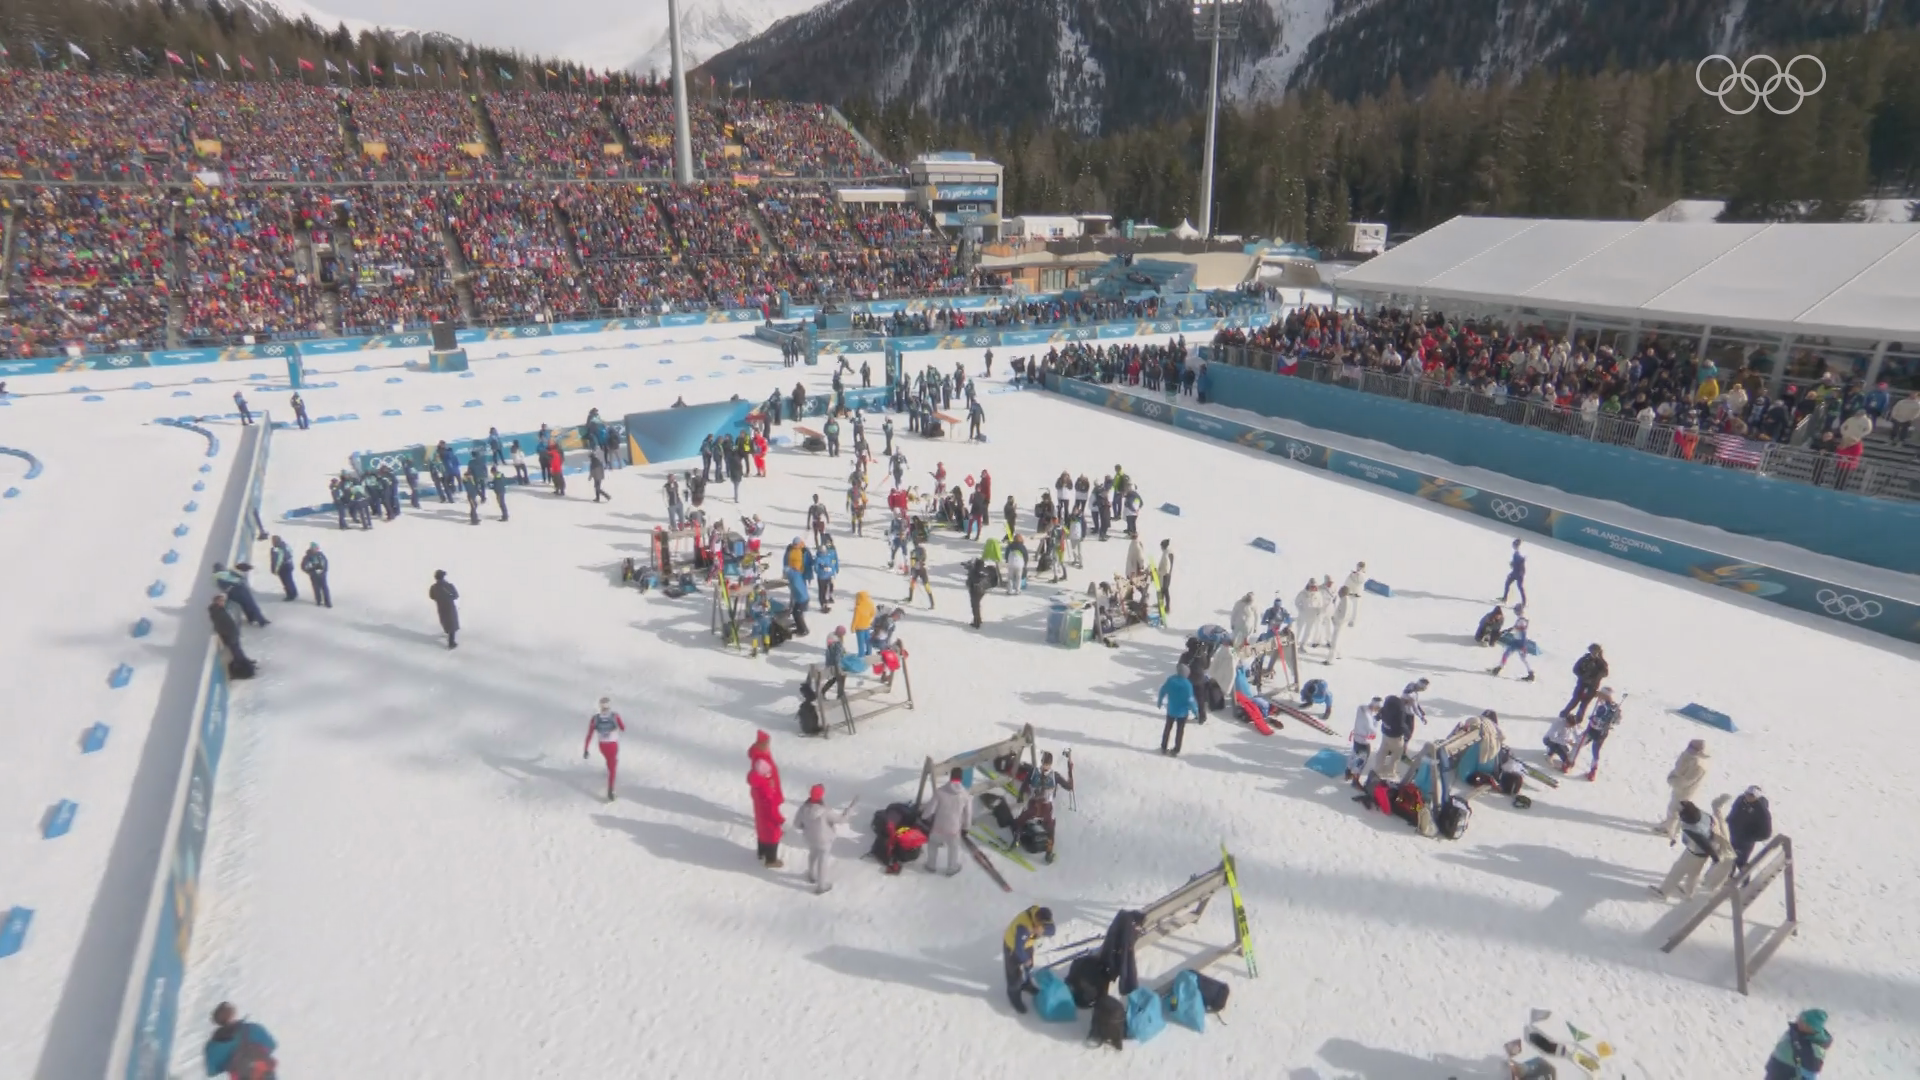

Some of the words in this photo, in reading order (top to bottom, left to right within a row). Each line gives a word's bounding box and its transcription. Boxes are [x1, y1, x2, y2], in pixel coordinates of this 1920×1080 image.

[1581, 527, 1620, 542] MILANO
[1621, 537, 1663, 555] CORTINA
[1609, 541, 1629, 553] 2026
